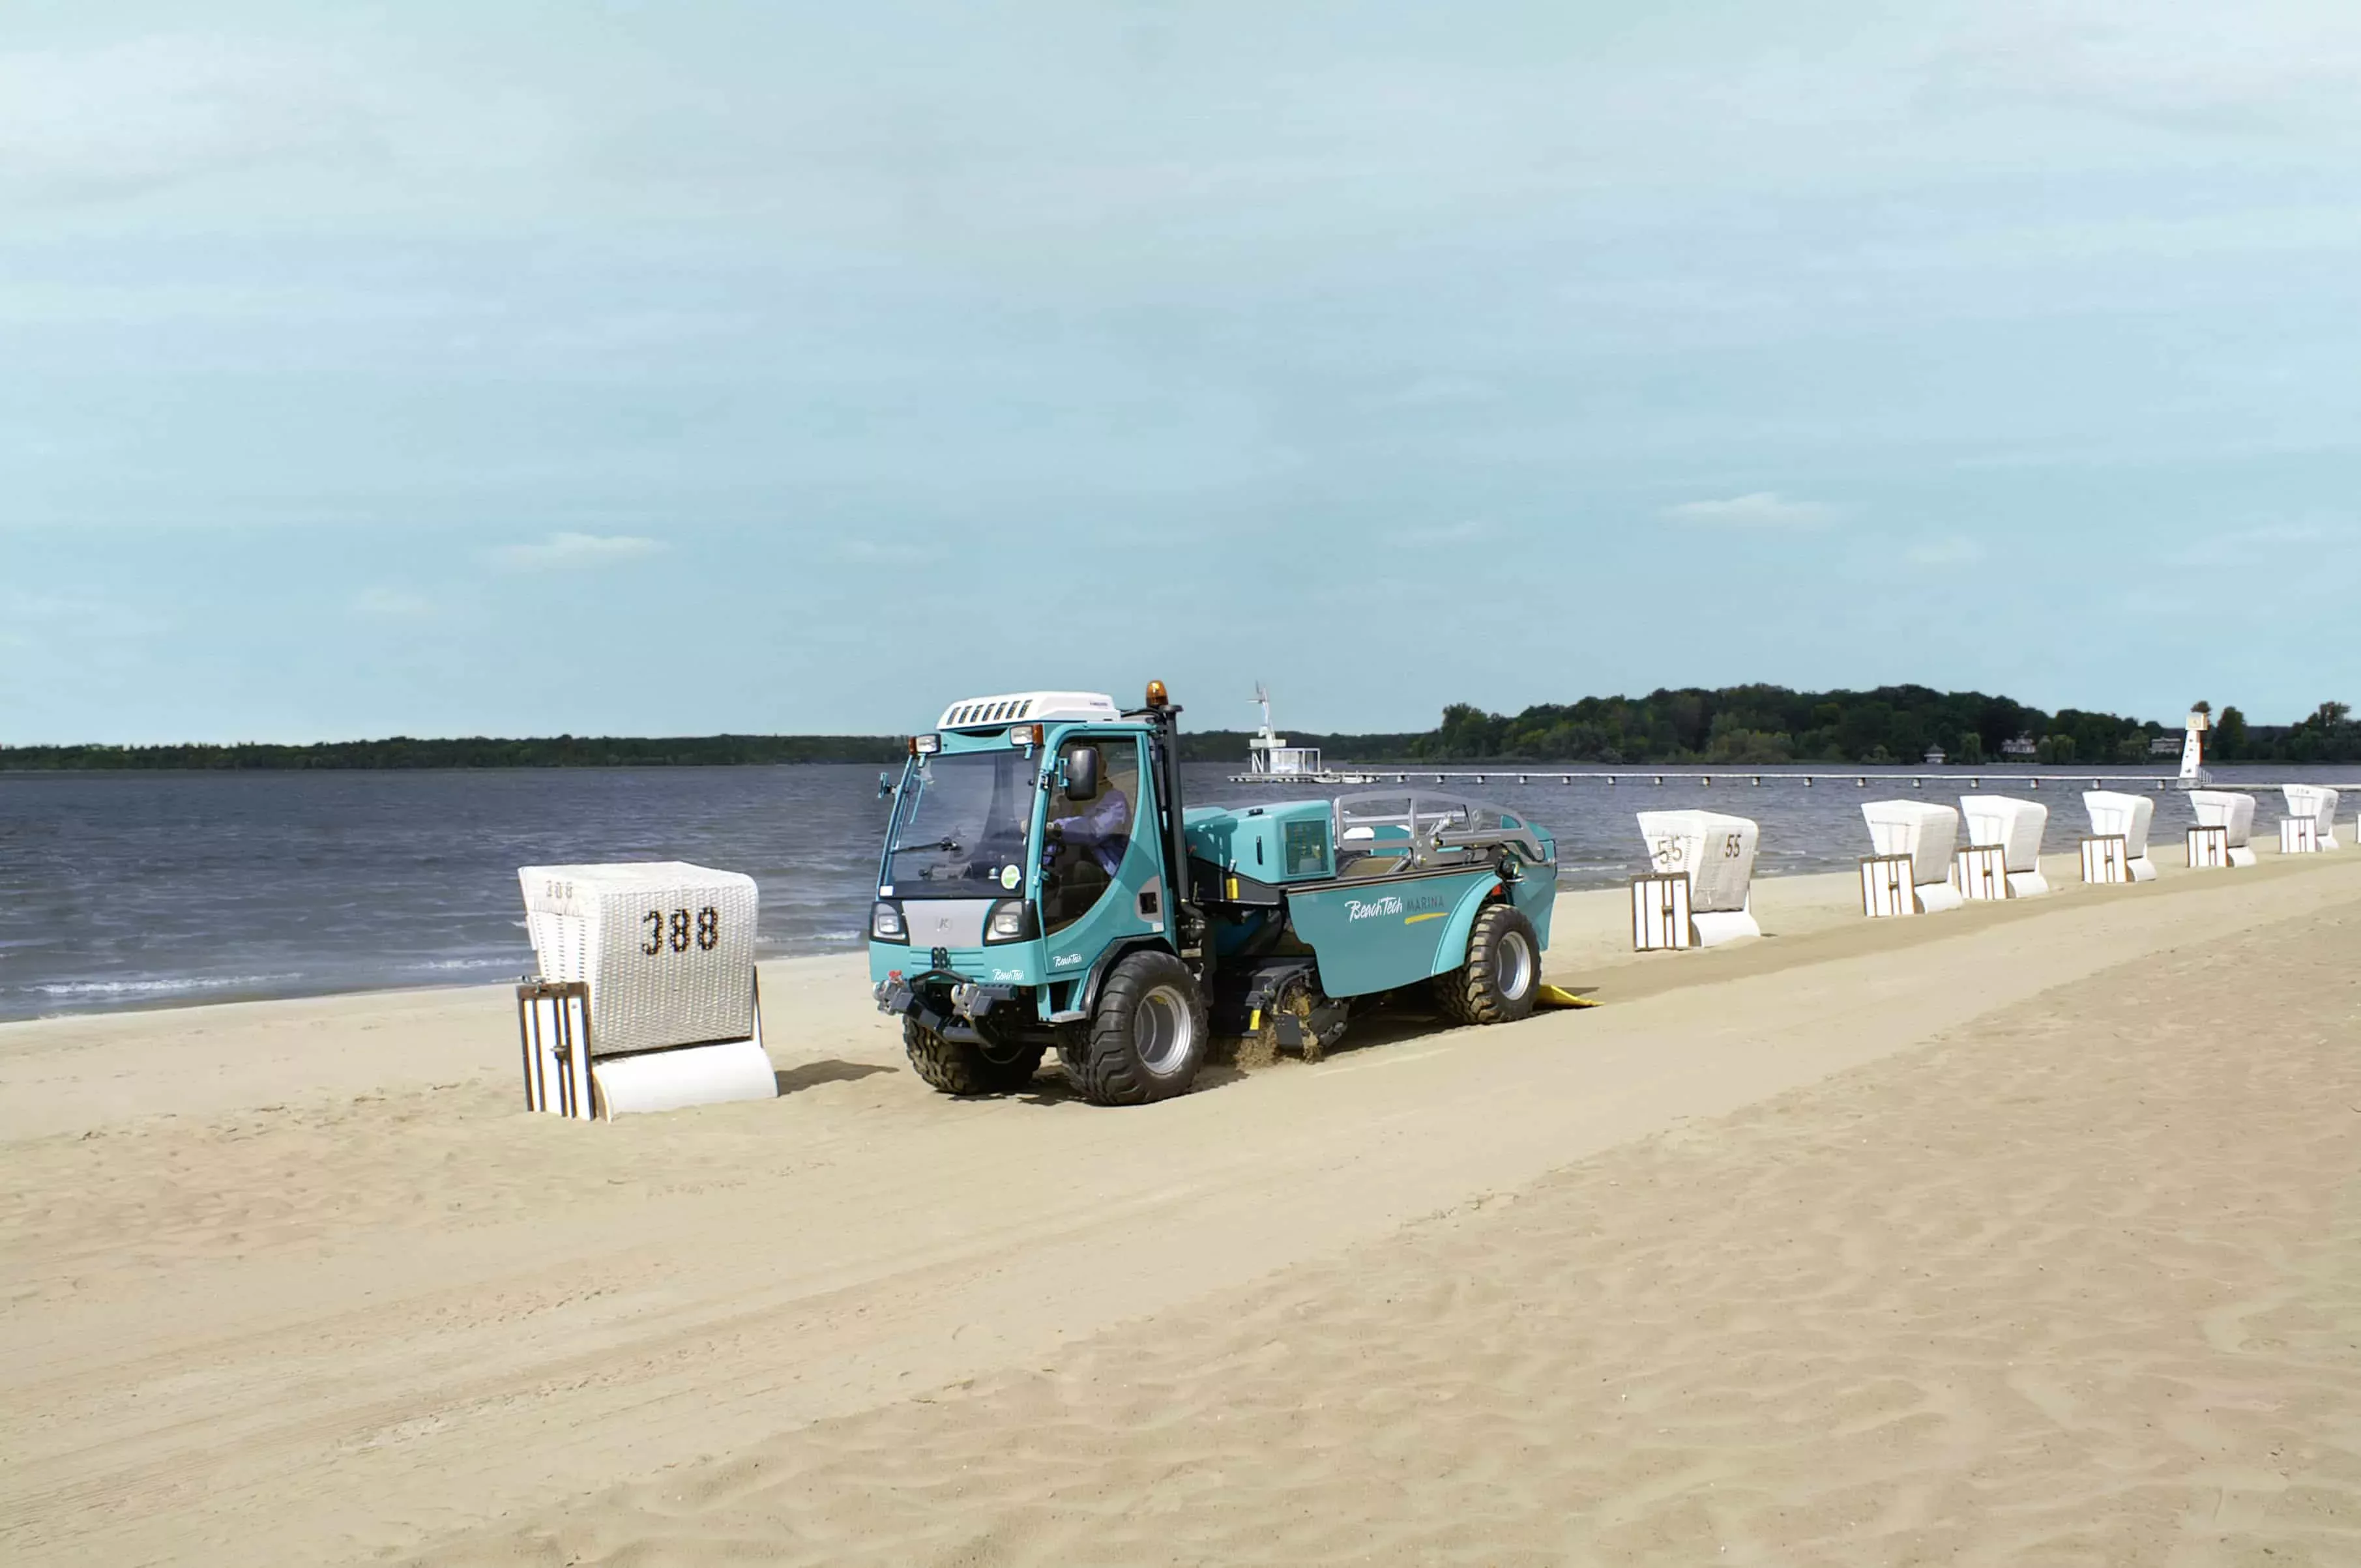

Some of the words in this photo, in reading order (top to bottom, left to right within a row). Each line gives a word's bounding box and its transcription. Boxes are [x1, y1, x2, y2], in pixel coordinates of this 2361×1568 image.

[1657, 836, 1682, 864] 55
[1725, 834, 1741, 858] 55
[1344, 896, 1403, 923] BeachTech
[1407, 895, 1444, 912] MARINA
[641, 907, 718, 955] 388
